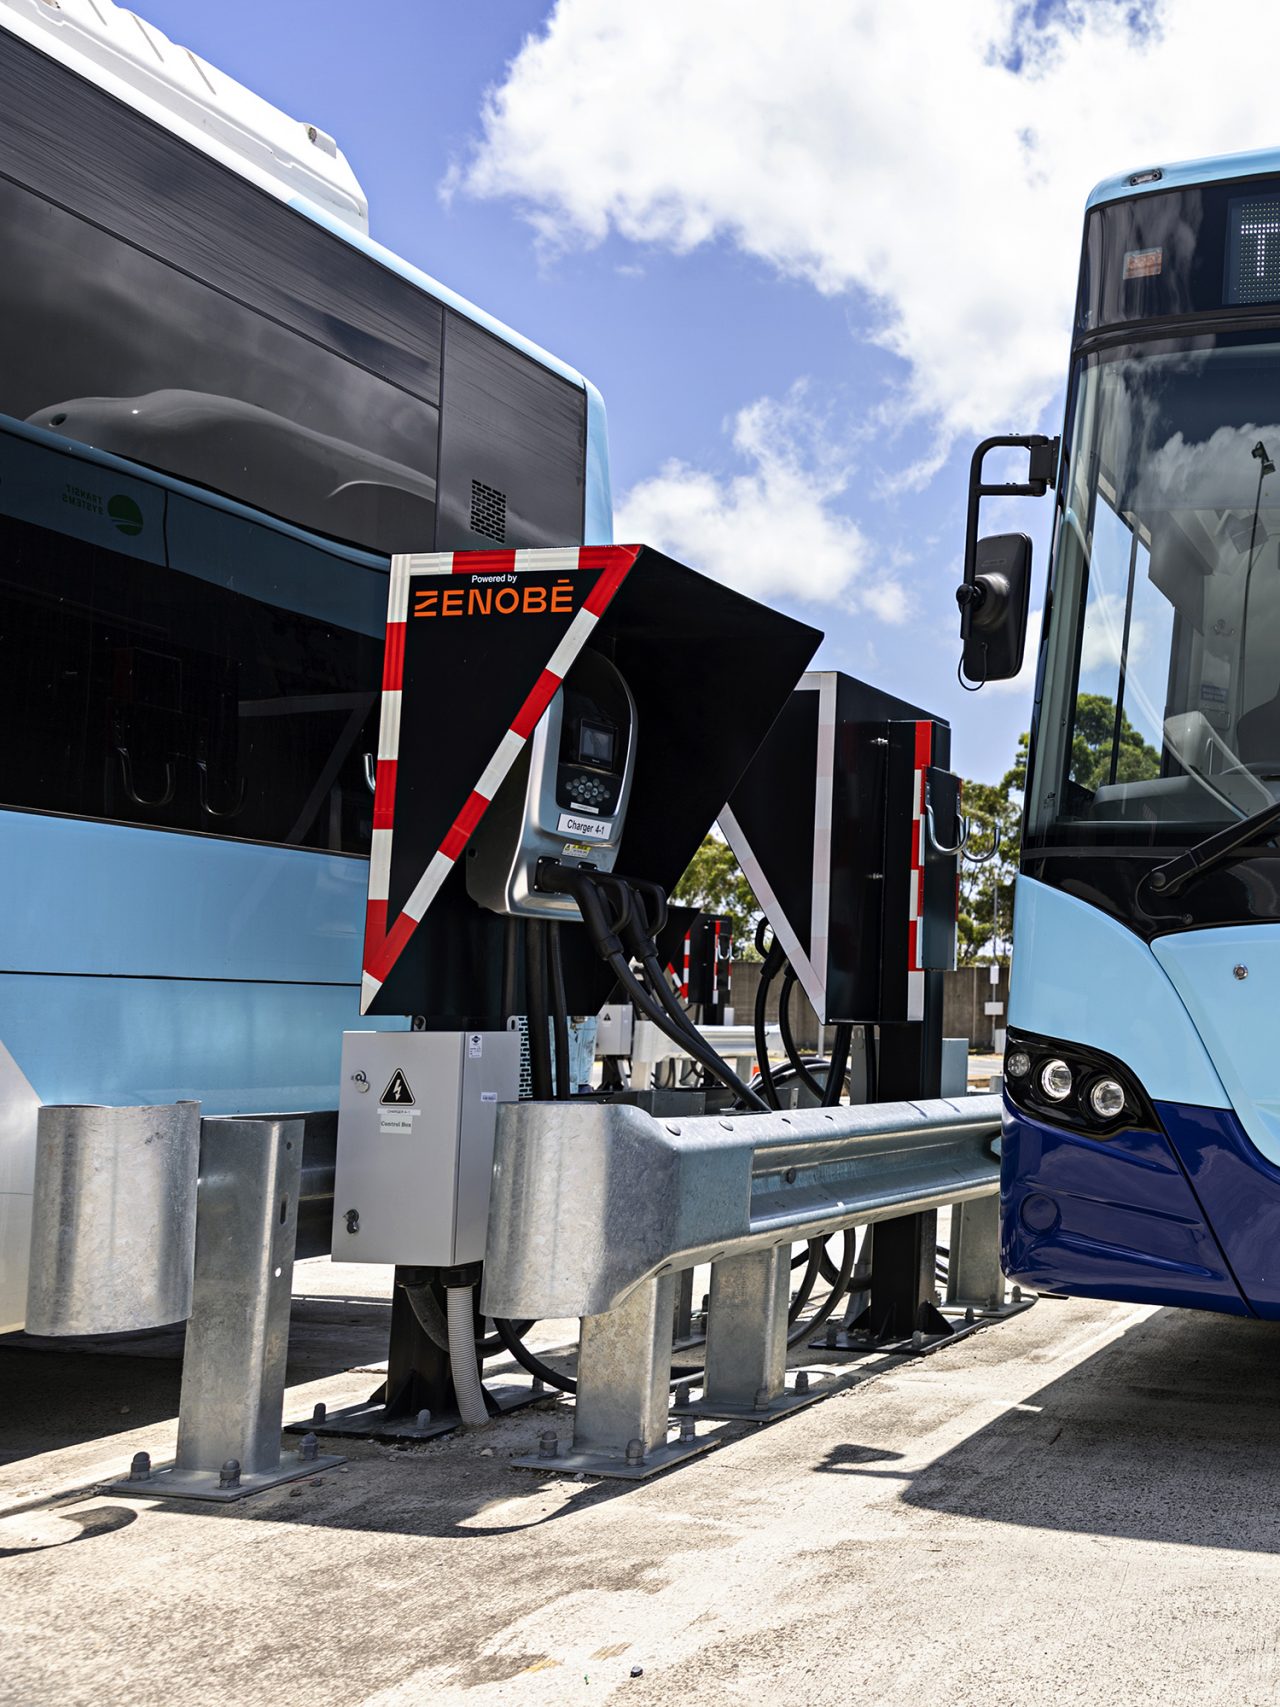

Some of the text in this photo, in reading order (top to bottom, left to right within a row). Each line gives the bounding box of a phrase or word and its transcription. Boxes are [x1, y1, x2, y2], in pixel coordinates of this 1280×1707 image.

[471, 574, 518, 584] Powered by
[567, 819, 605, 835] Charger 4-1
